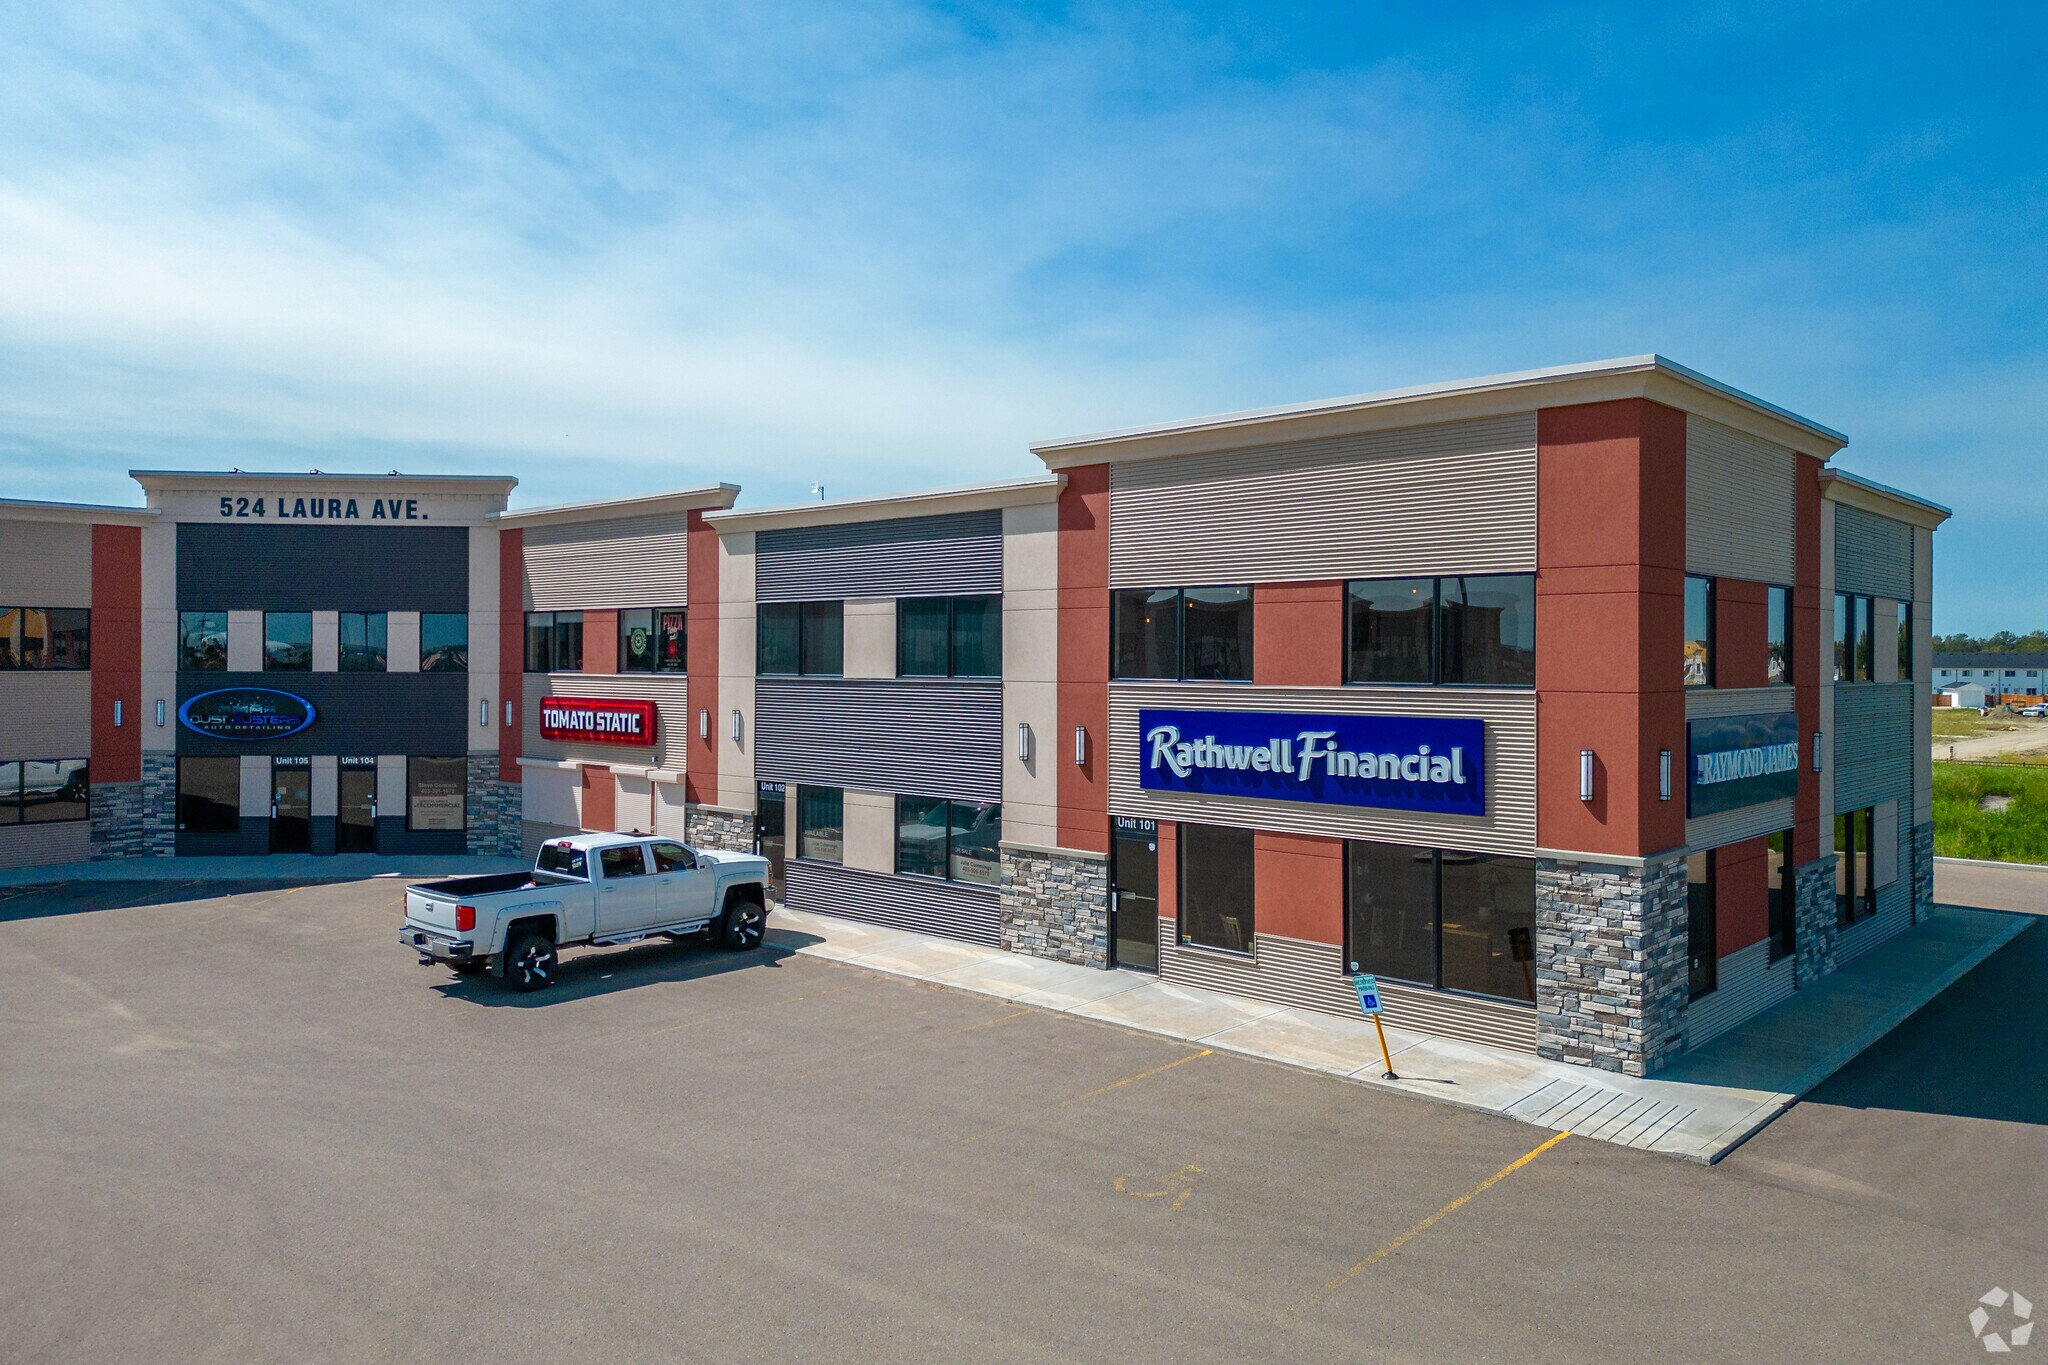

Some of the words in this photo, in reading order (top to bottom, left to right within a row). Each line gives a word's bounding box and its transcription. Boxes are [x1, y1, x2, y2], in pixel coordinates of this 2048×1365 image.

[220, 497, 265, 517] 524
[278, 498, 359, 518] LAURA
[371, 499, 428, 520] AVE.
[663, 614, 683, 630] PIZZA
[543, 709, 594, 730] TOMATO
[596, 711, 640, 733] STATIC
[276, 757, 293, 765] Unit
[295, 757, 309, 765] 105
[342, 757, 359, 765] Unit
[361, 757, 374, 765] 104
[1147, 725, 1295, 778] Rathwell
[1296, 731, 1467, 784] Financial
[1697, 748, 1763, 784] RAYMOND
[1764, 741, 1799, 775] JAMES
[761, 782, 774, 792] Unit
[775, 783, 785, 792] 102
[1117, 817, 1137, 829] Unit
[1139, 820, 1155, 831] 101
